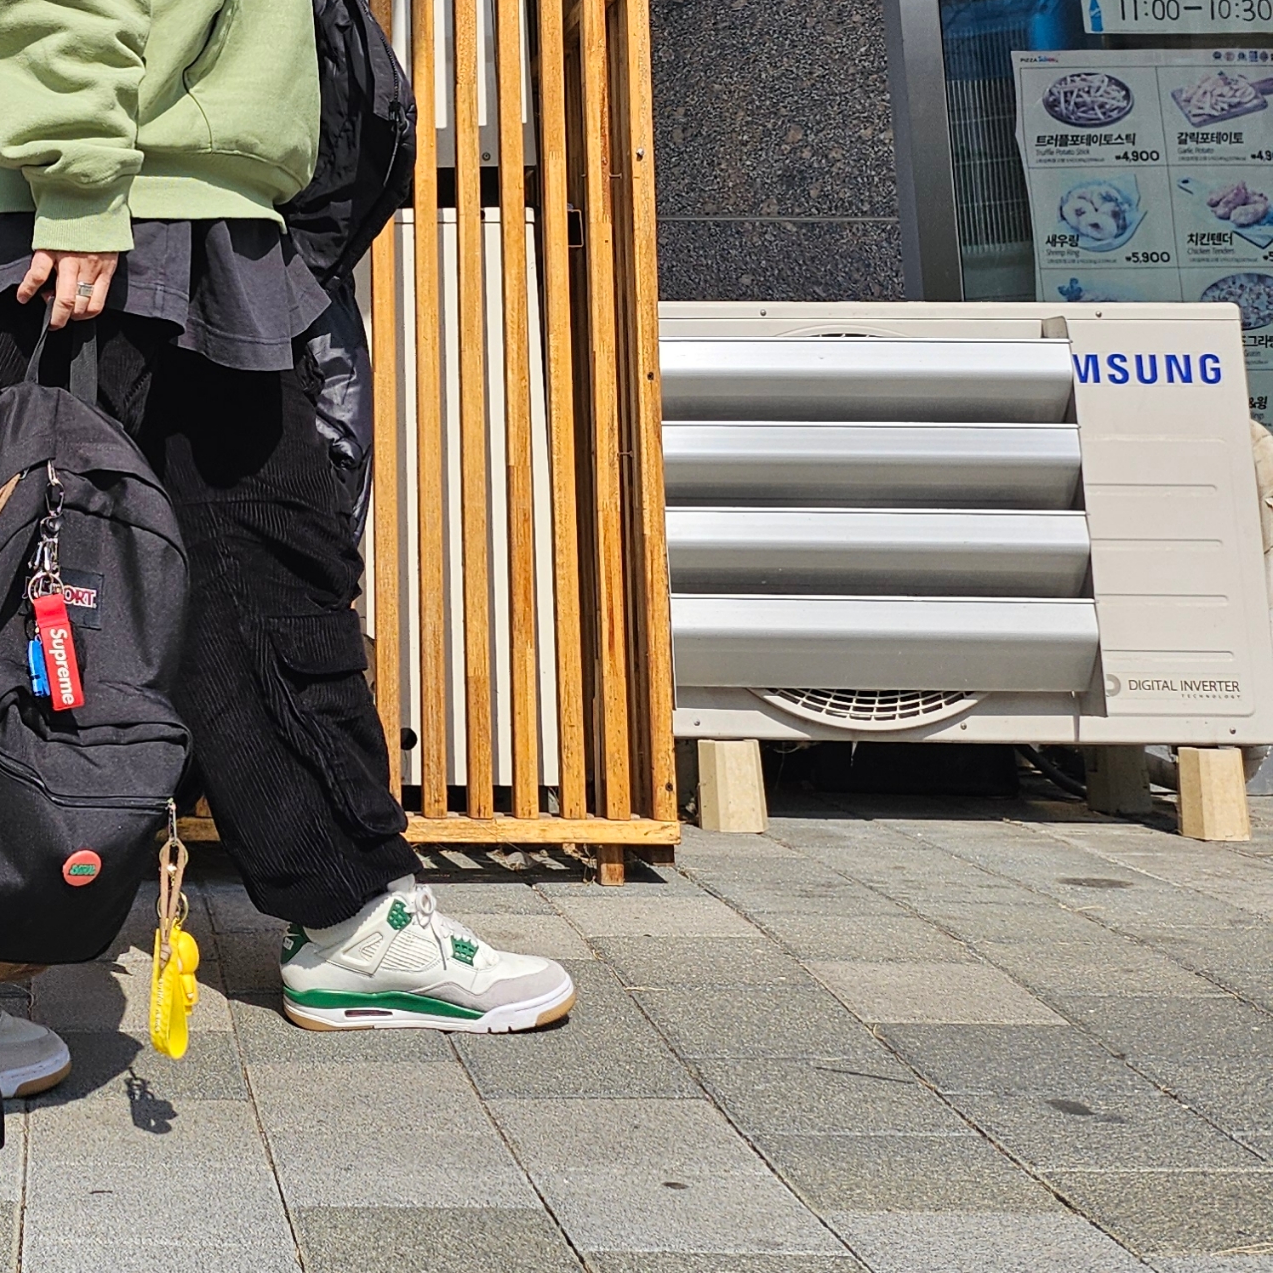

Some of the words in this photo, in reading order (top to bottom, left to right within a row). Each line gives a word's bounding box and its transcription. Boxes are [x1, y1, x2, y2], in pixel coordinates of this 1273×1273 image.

[1035, 133, 1136, 147] 트러플포테이토스틱
[1177, 131, 1244, 145] 갈릭포테이토
[1046, 234, 1080, 247] 새우링
[1187, 232, 1233, 246] 치킨텐더
[49, 628, 75, 705] Supreme
[1128, 679, 1178, 691] DIGITAL
[1180, 680, 1240, 692] INVERTER
